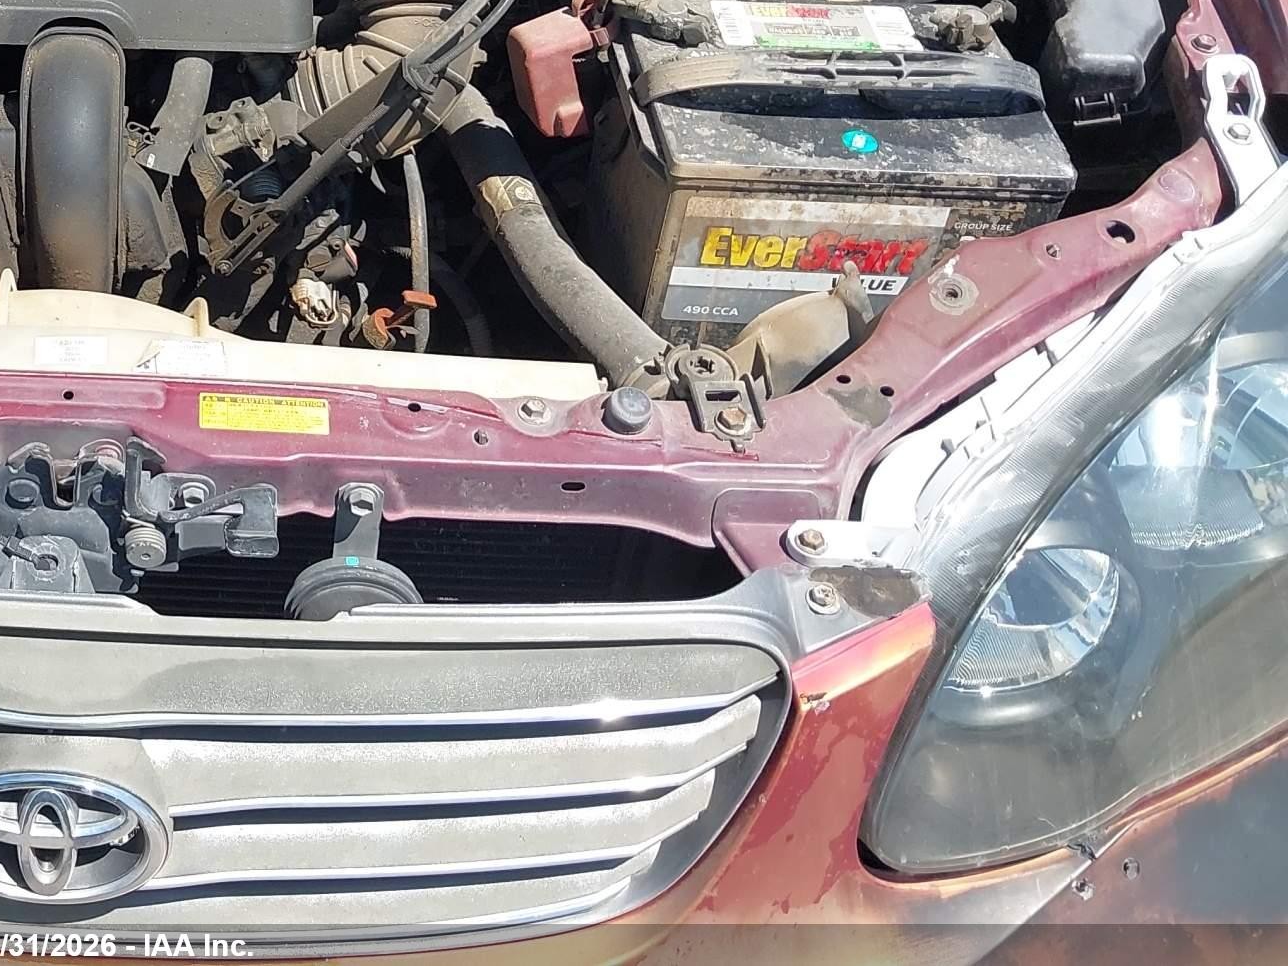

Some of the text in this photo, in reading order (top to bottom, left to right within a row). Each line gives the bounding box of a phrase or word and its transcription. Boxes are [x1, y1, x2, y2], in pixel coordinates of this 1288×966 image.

[954, 221, 1014, 232] GROUP SIZE
[683, 305, 739, 316] 490 CCA
